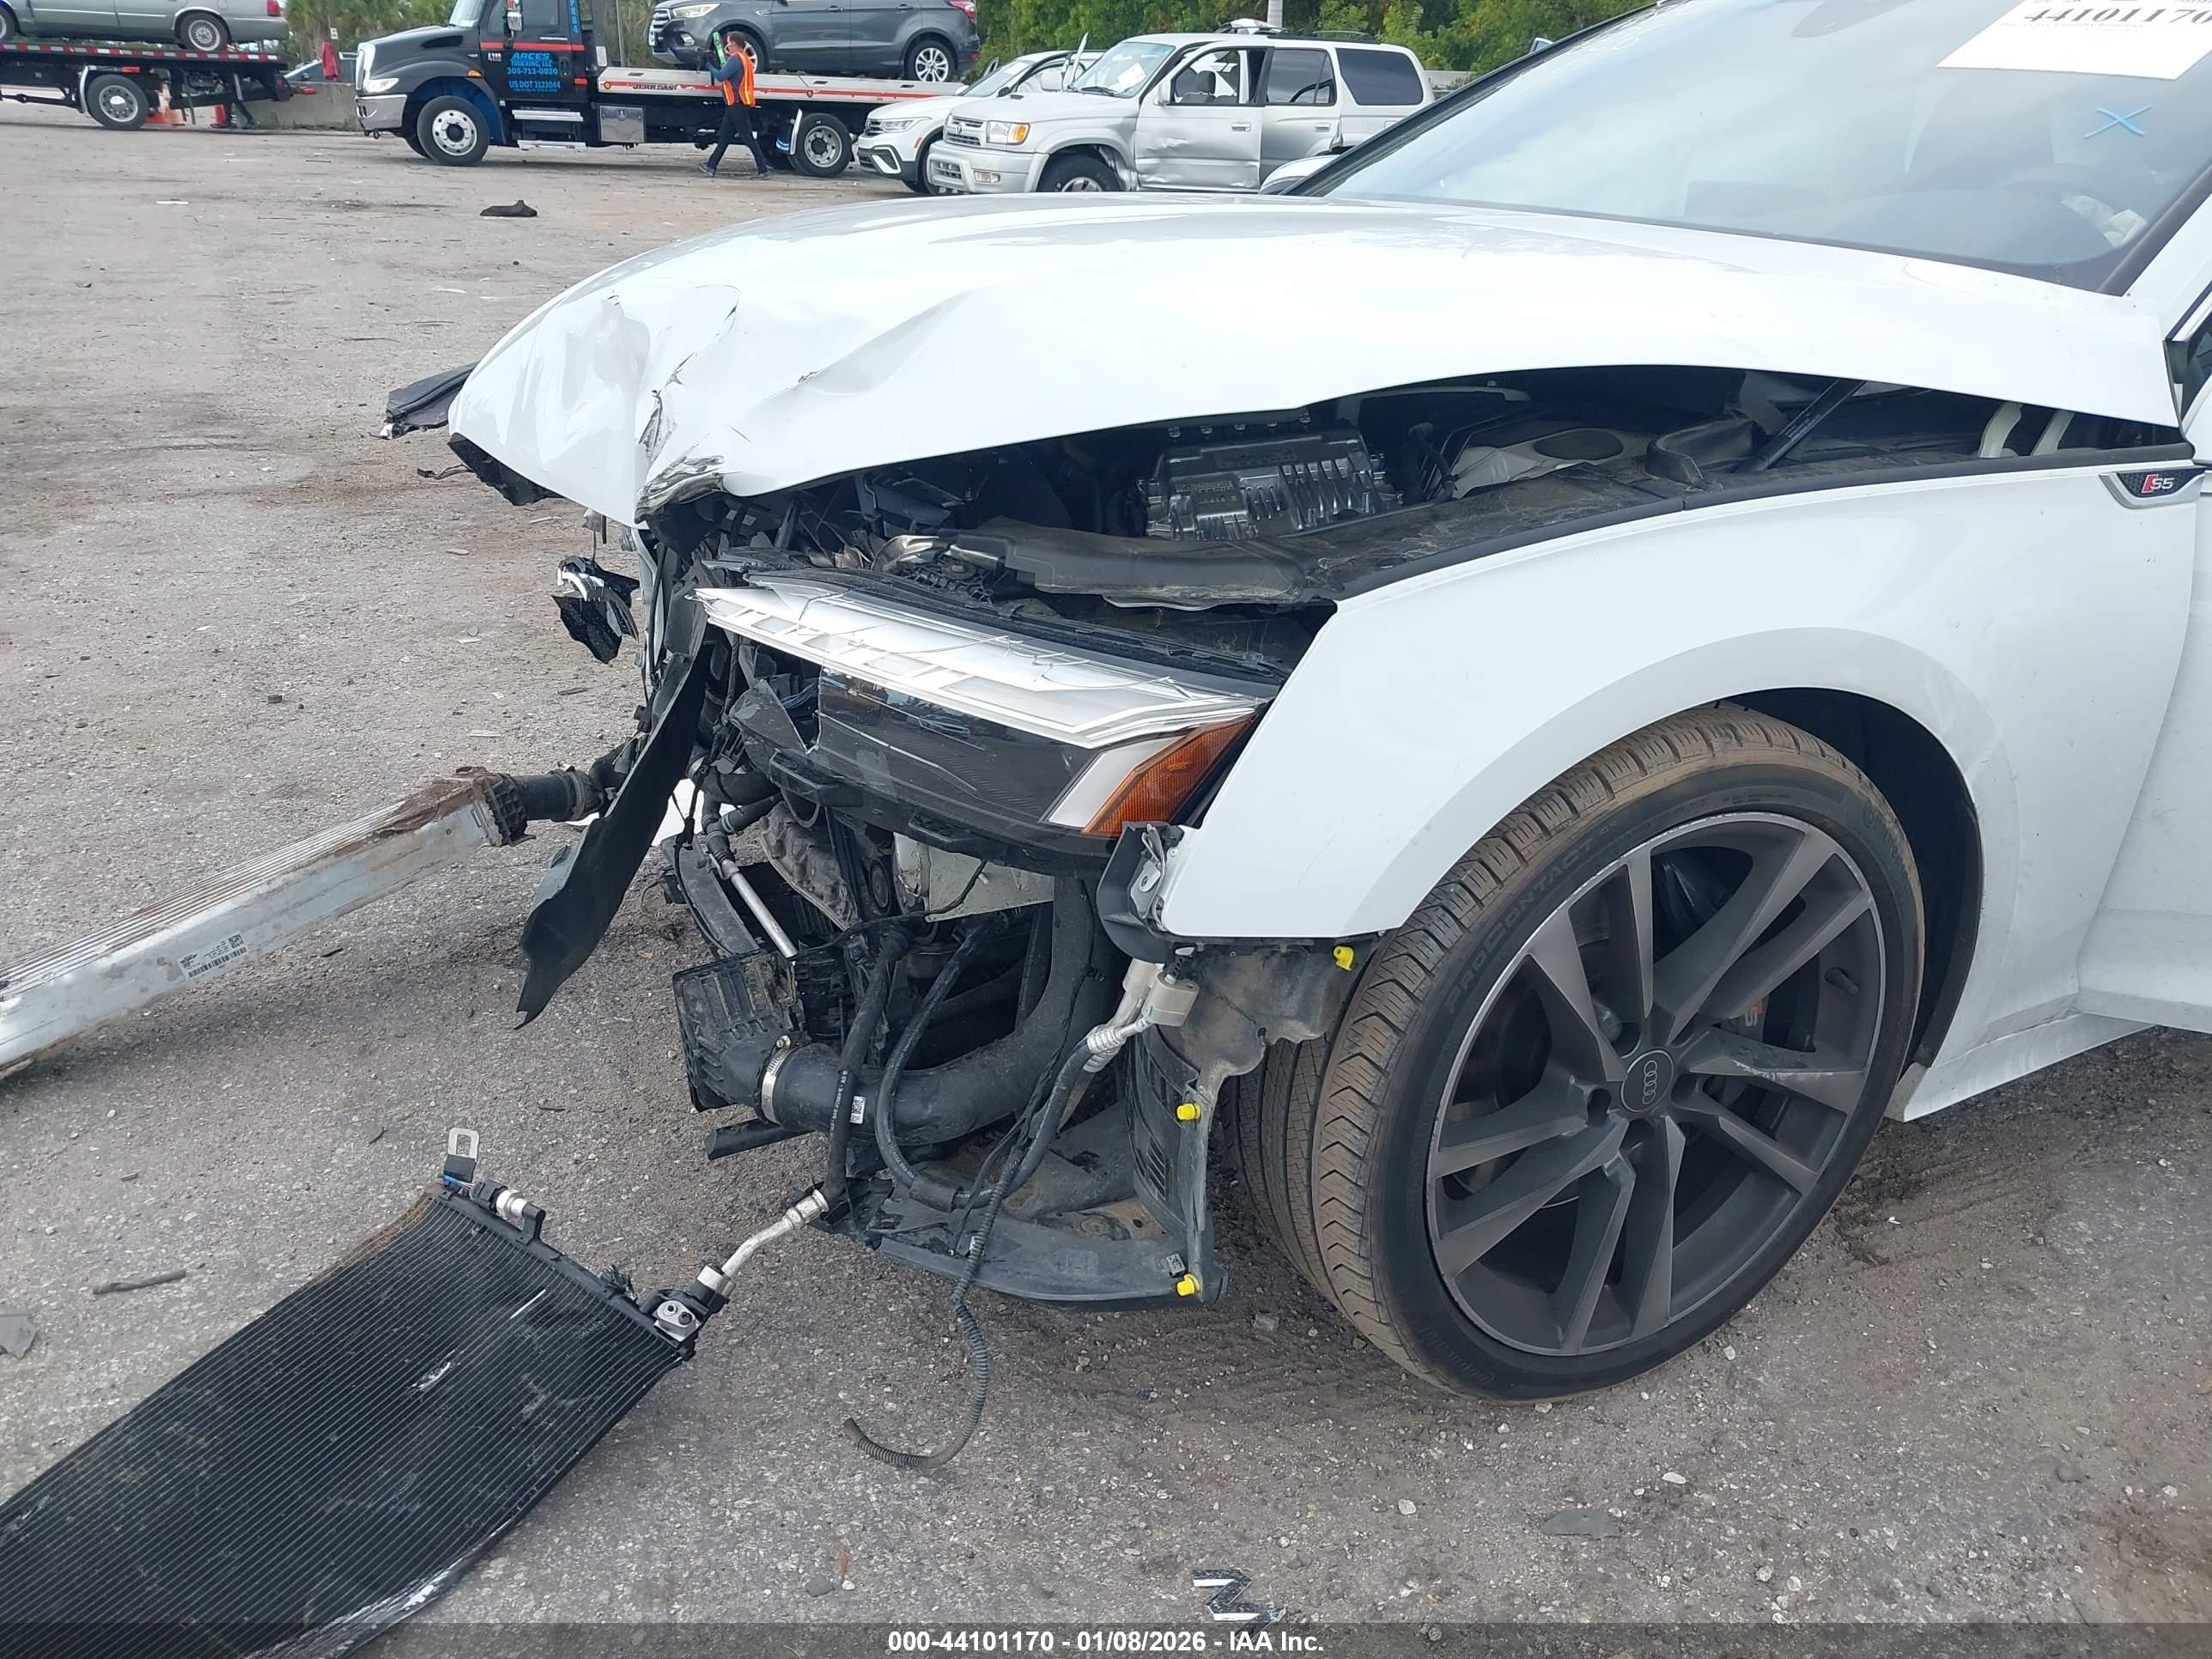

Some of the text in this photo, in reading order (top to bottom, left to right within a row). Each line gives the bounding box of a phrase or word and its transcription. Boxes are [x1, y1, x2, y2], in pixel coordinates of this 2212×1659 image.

[2024, 9, 2212, 25] 44101170
[507, 67, 558, 76] 305-713-0020
[2148, 477, 2175, 490] S5
